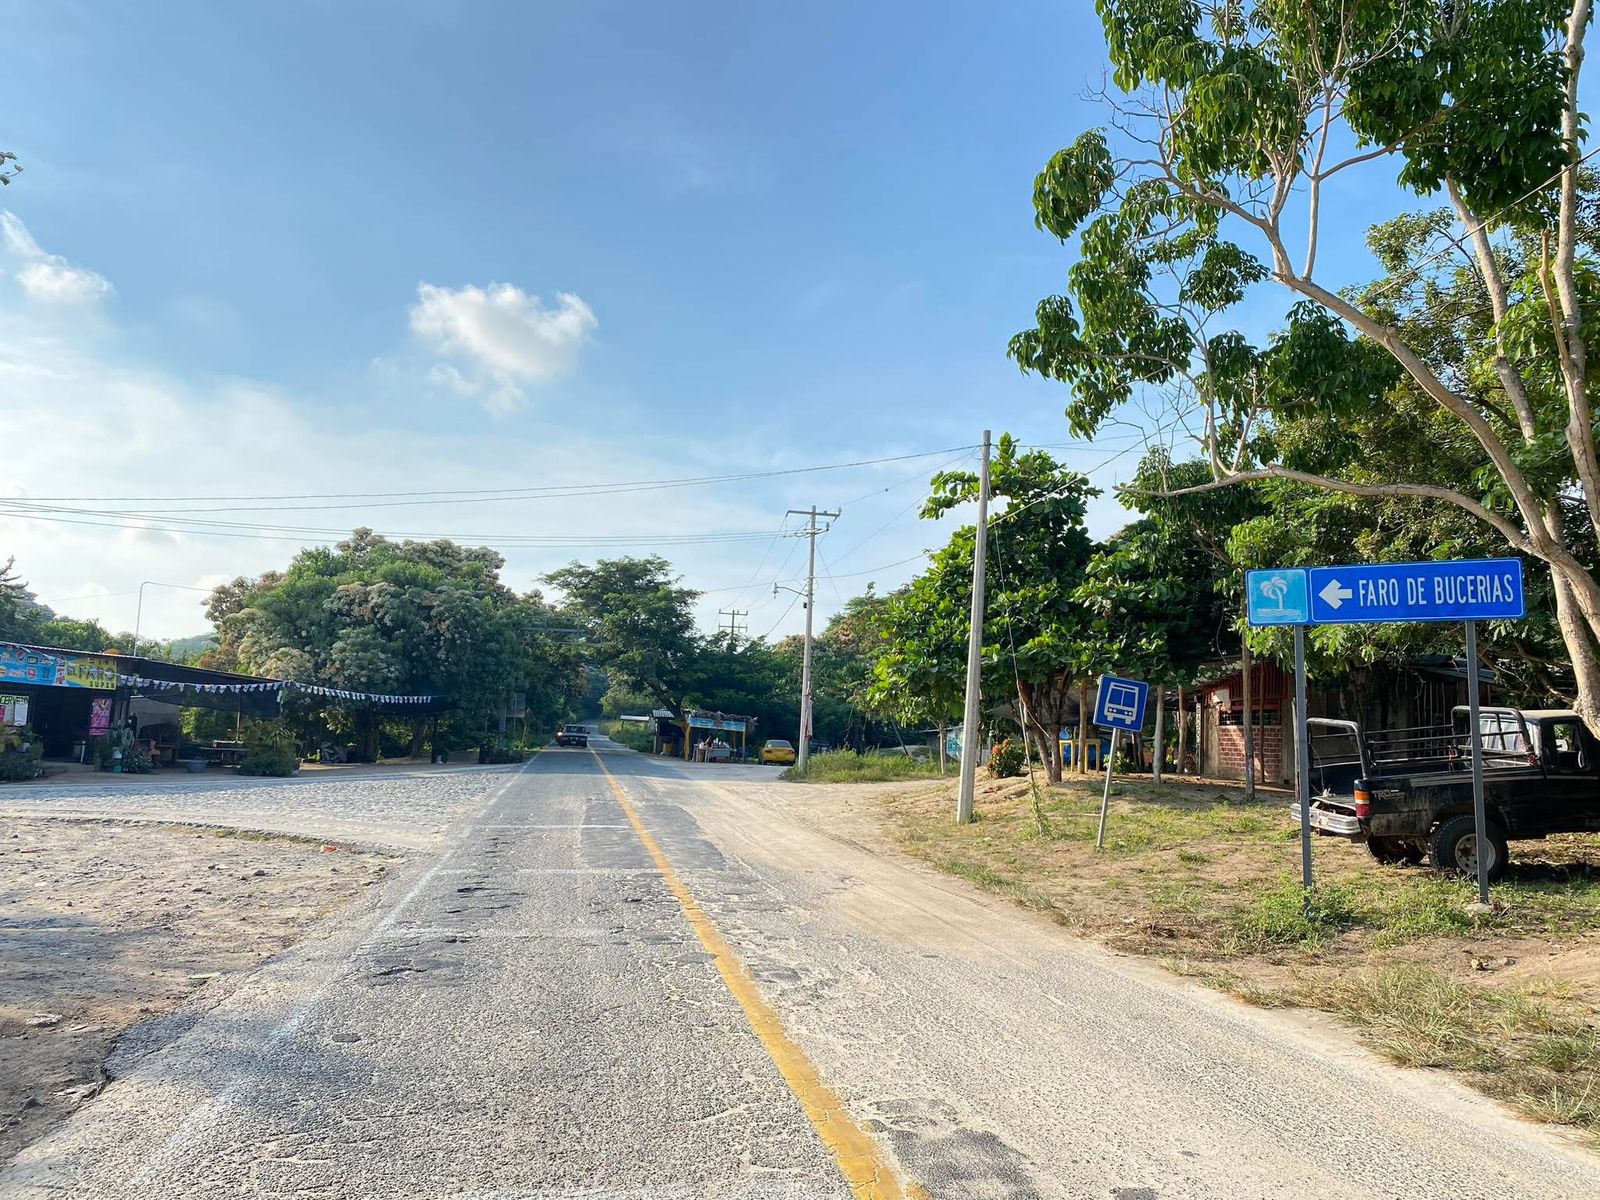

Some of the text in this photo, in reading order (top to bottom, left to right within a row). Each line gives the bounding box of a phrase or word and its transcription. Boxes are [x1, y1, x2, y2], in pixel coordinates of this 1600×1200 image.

[1358, 574, 1514, 607] FARO DE BUCERIAS
